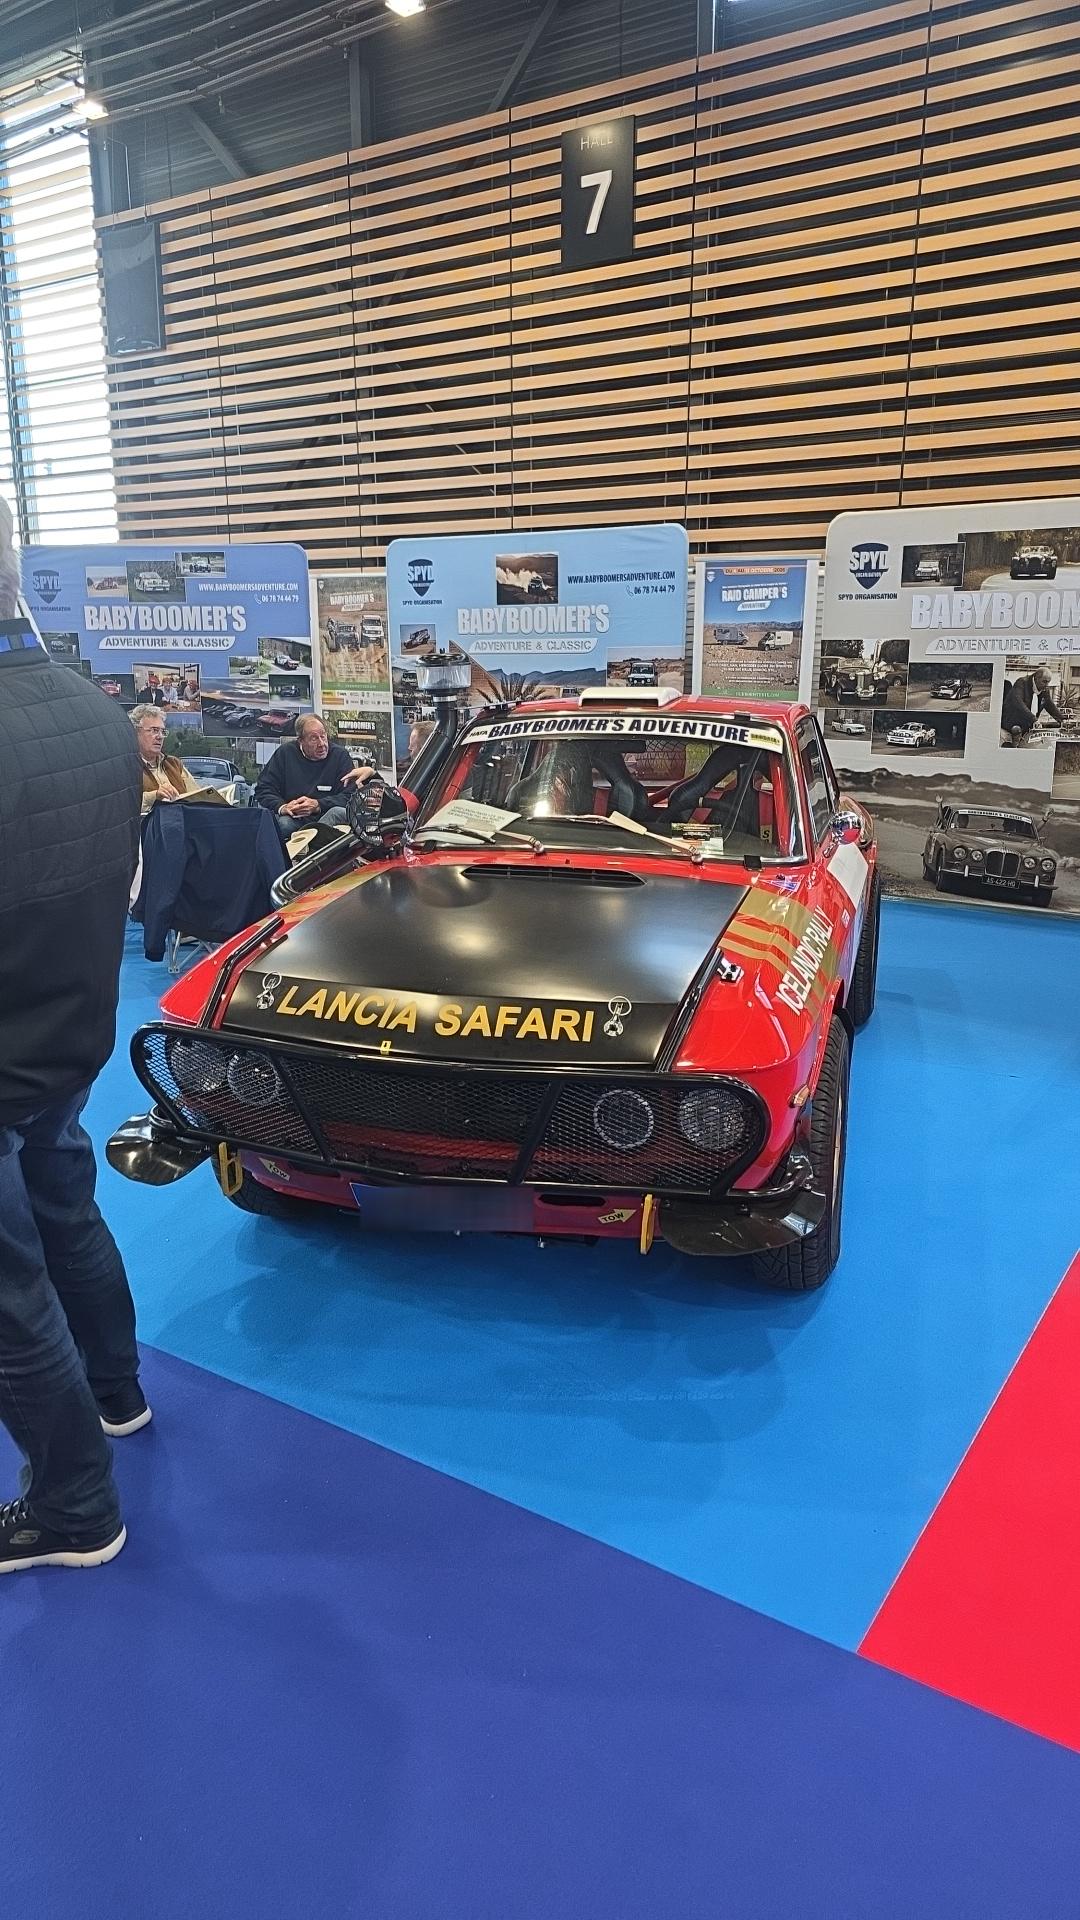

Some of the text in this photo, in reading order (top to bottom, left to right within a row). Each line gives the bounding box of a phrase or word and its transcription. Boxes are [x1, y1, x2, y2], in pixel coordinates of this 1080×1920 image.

[581, 170, 613, 234] 7
[850, 551, 889, 571] SPYD
[408, 565, 433, 581] SPYD
[568, 571, 676, 584] WWW.BABYBOOMERSADVENTURE.COM
[33, 576, 60, 590] SPYD
[643, 586, 650, 594] 78
[722, 589, 742, 602] RAID
[84, 606, 246, 631] BABYBOOMER'S
[458, 605, 609, 634] BABYBOOMER'S
[105, 637, 230, 648] ADVENTURE & CLASSIC
[474, 640, 592, 651] ADVENTURE & CLASSIC
[935, 638, 1032, 651] ADVENTURE
[1038, 639, 1049, 651] &
[488, 719, 625, 738] BABYBOOMER'S
[629, 719, 750, 743] ADVENTURE
[775, 905, 834, 1016] ICELANDIC RALLY
[276, 985, 595, 1042] LANCIA SAFARI
[269, 1162, 288, 1178] TOW
[601, 1212, 624, 1222] TOW
